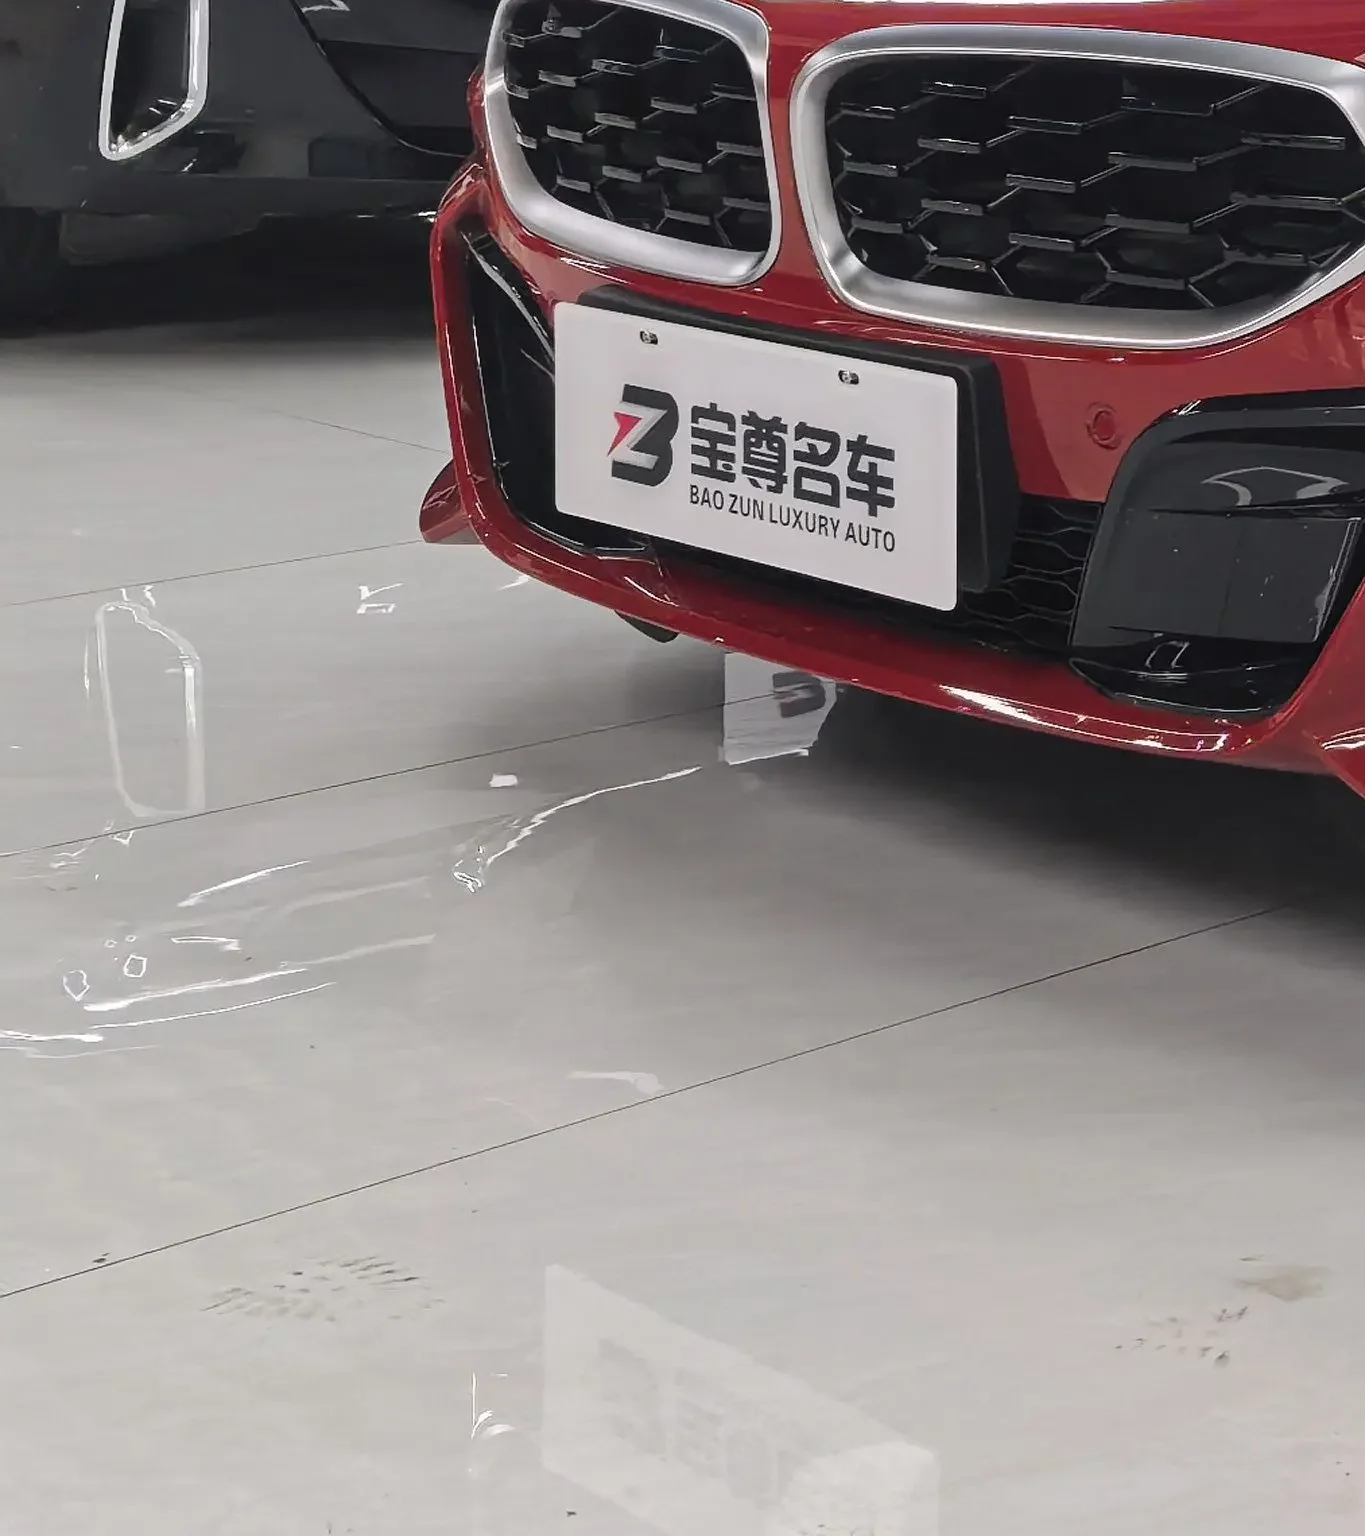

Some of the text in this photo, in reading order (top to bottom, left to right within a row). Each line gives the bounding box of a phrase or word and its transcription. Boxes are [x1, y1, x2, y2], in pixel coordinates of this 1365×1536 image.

[690, 402, 896, 518] 宝尊名车
[689, 484, 896, 552] BAO ZUN LUXURY AUTO
